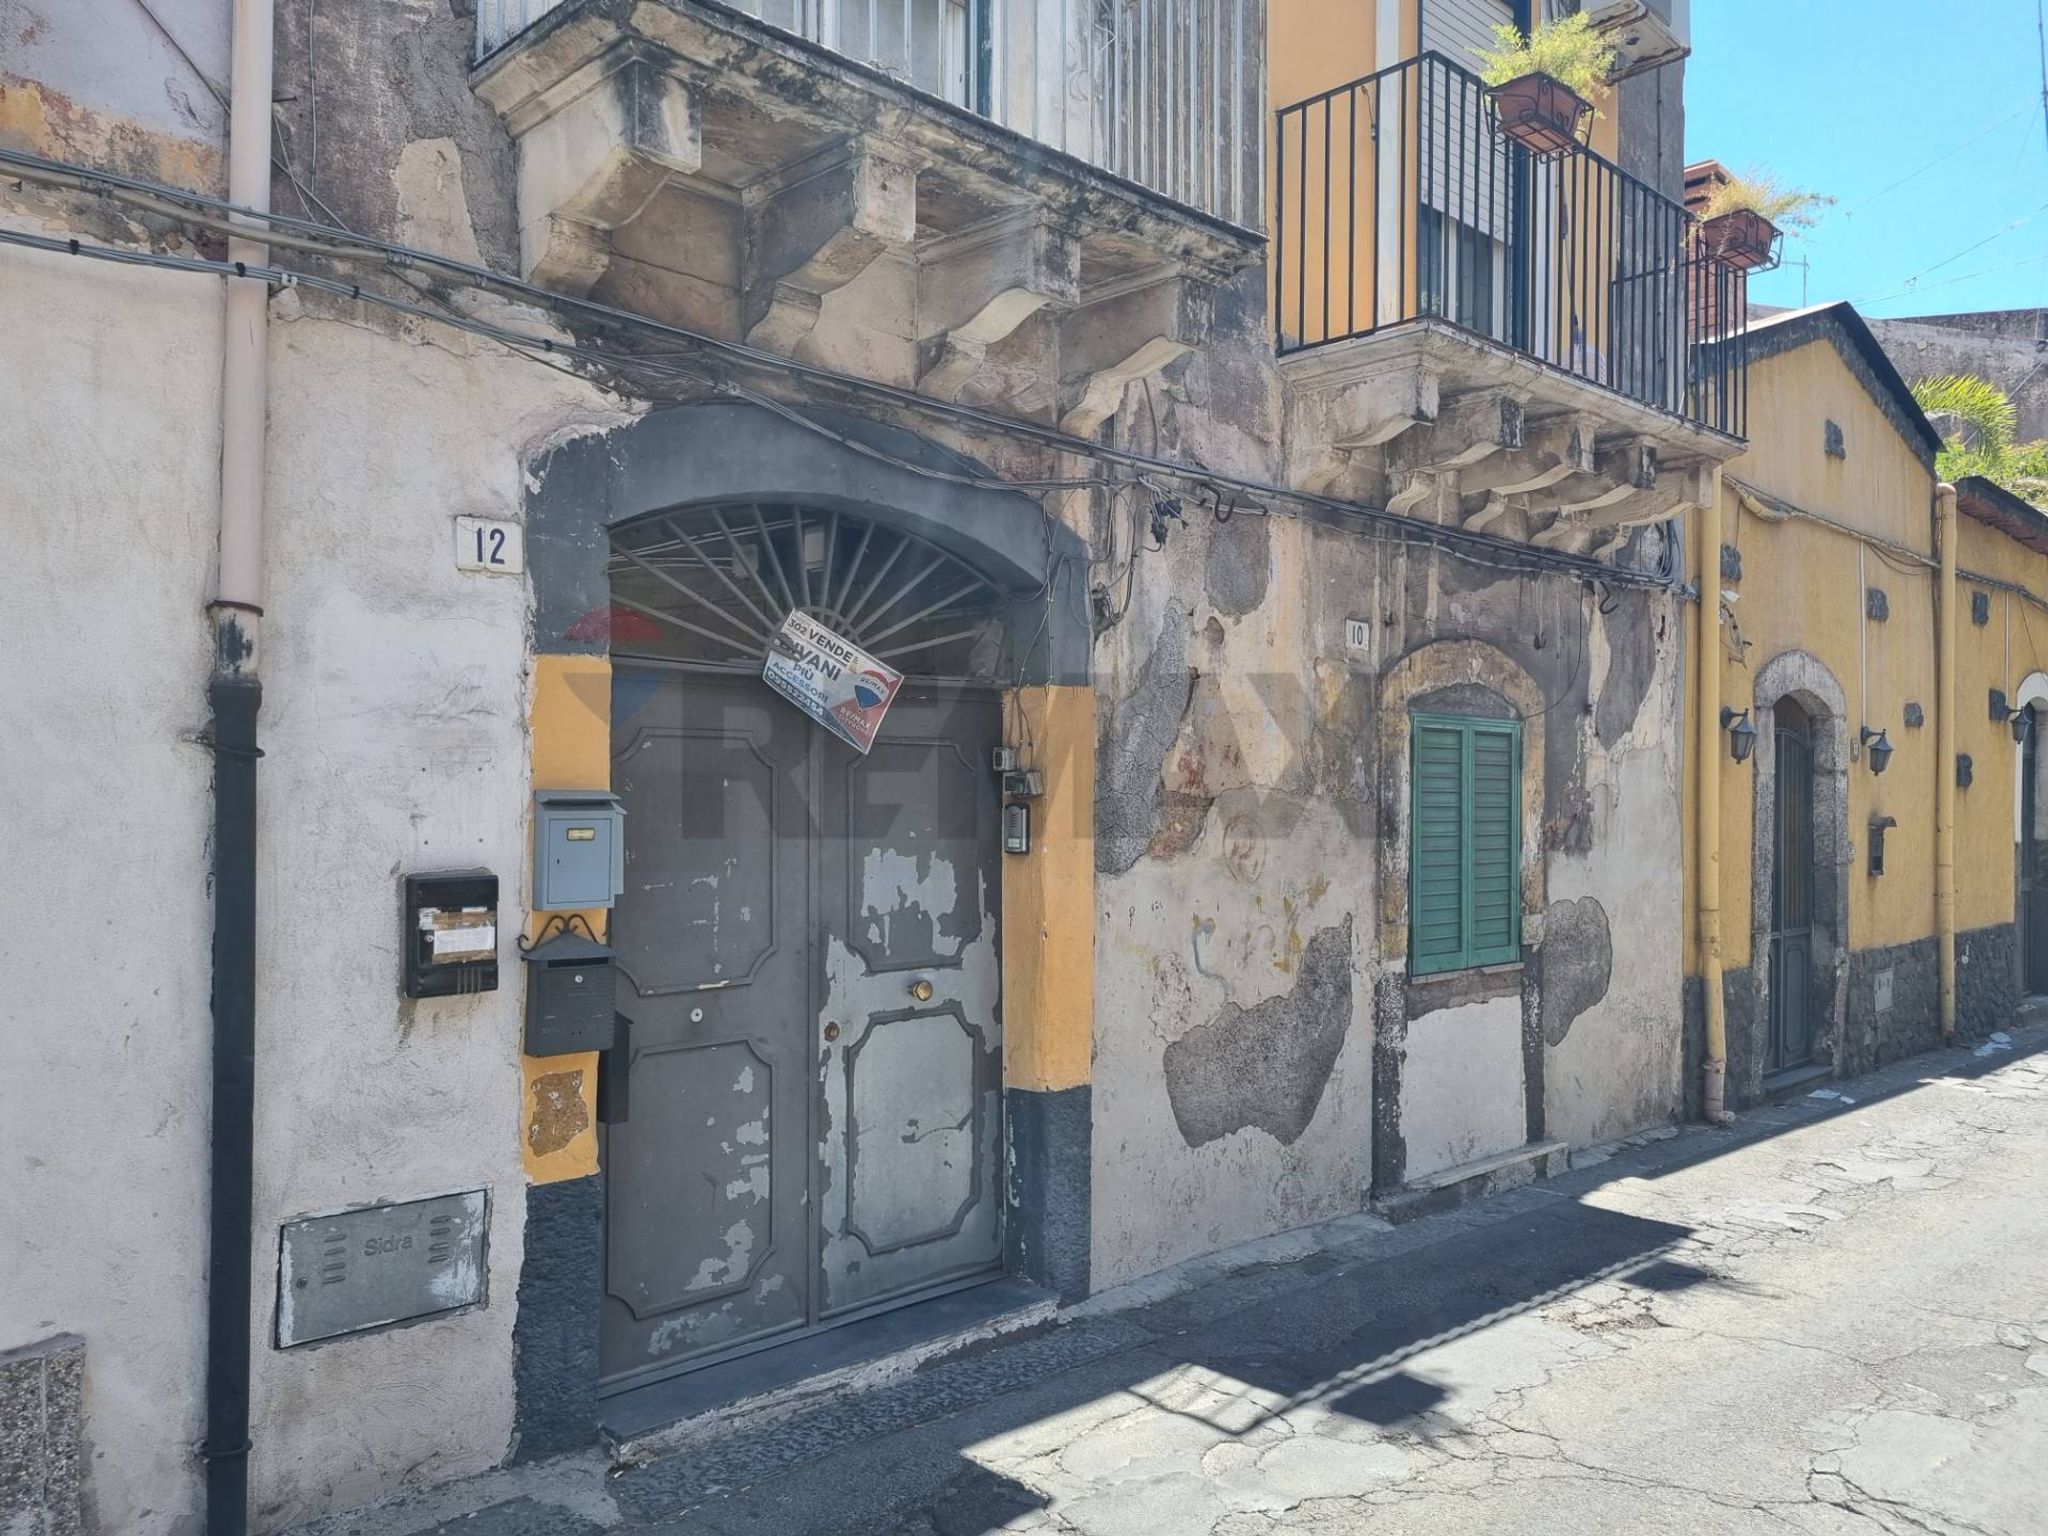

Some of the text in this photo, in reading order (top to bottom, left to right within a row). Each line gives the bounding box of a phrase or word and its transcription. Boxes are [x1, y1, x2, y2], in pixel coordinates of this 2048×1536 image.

[476, 527, 505, 565] 12
[809, 628, 853, 663] VENDE
[1352, 624, 1363, 646] 10
[773, 662, 828, 703] ACCESSORI
